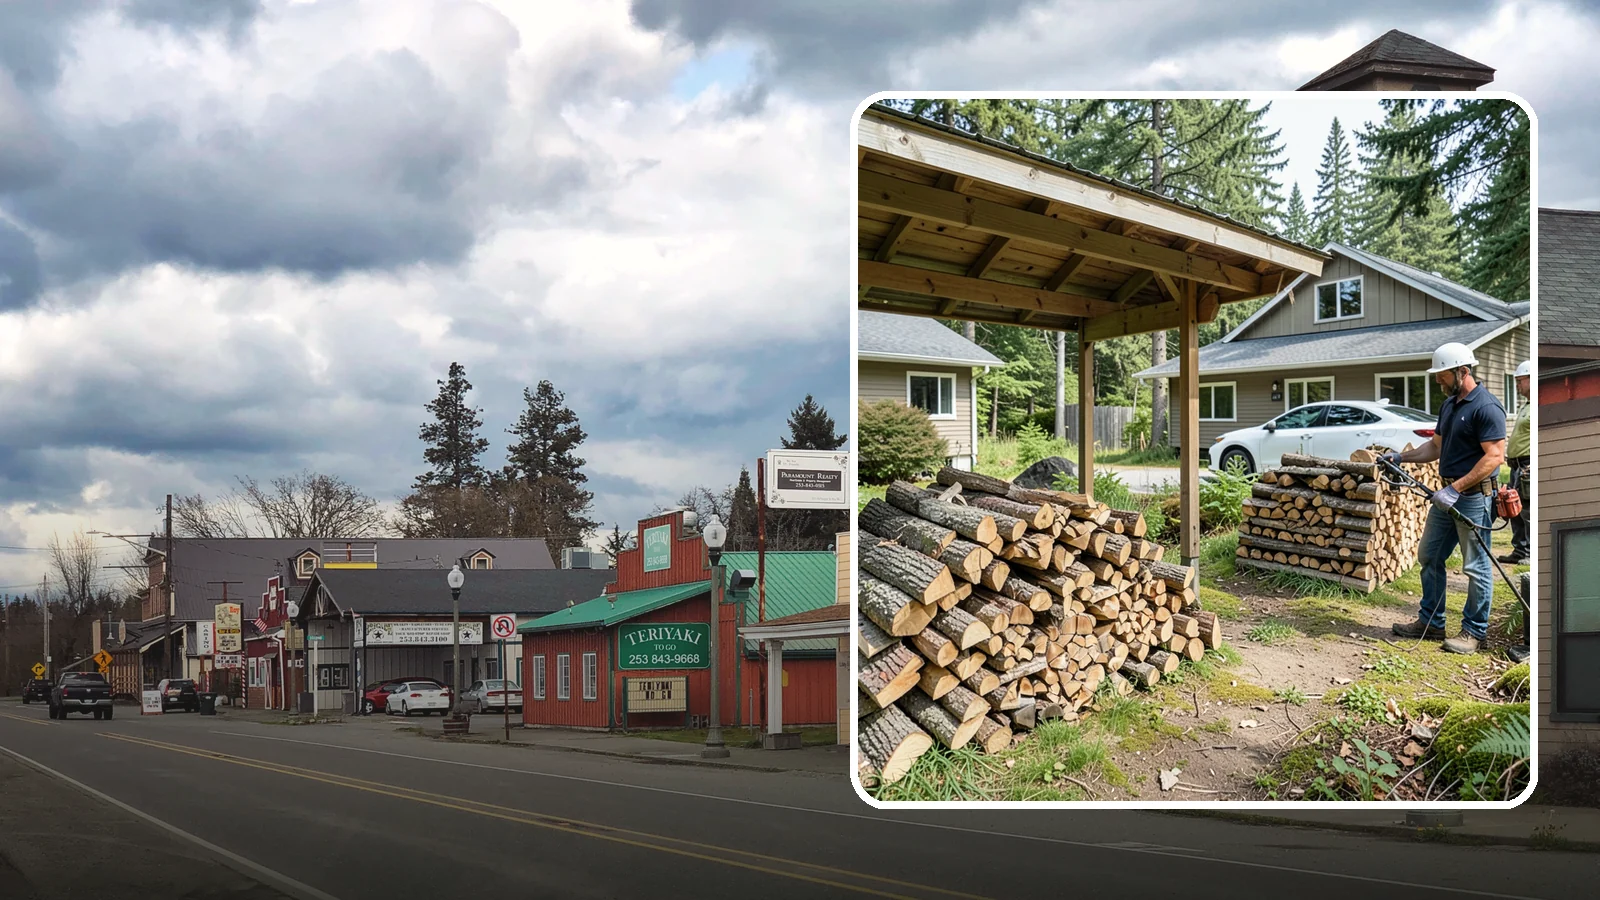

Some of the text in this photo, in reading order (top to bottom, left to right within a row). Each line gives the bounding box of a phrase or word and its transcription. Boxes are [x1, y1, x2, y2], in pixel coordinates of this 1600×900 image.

[625, 627, 702, 646] TERIYAKI
[629, 654, 700, 664] 253 843-9668
